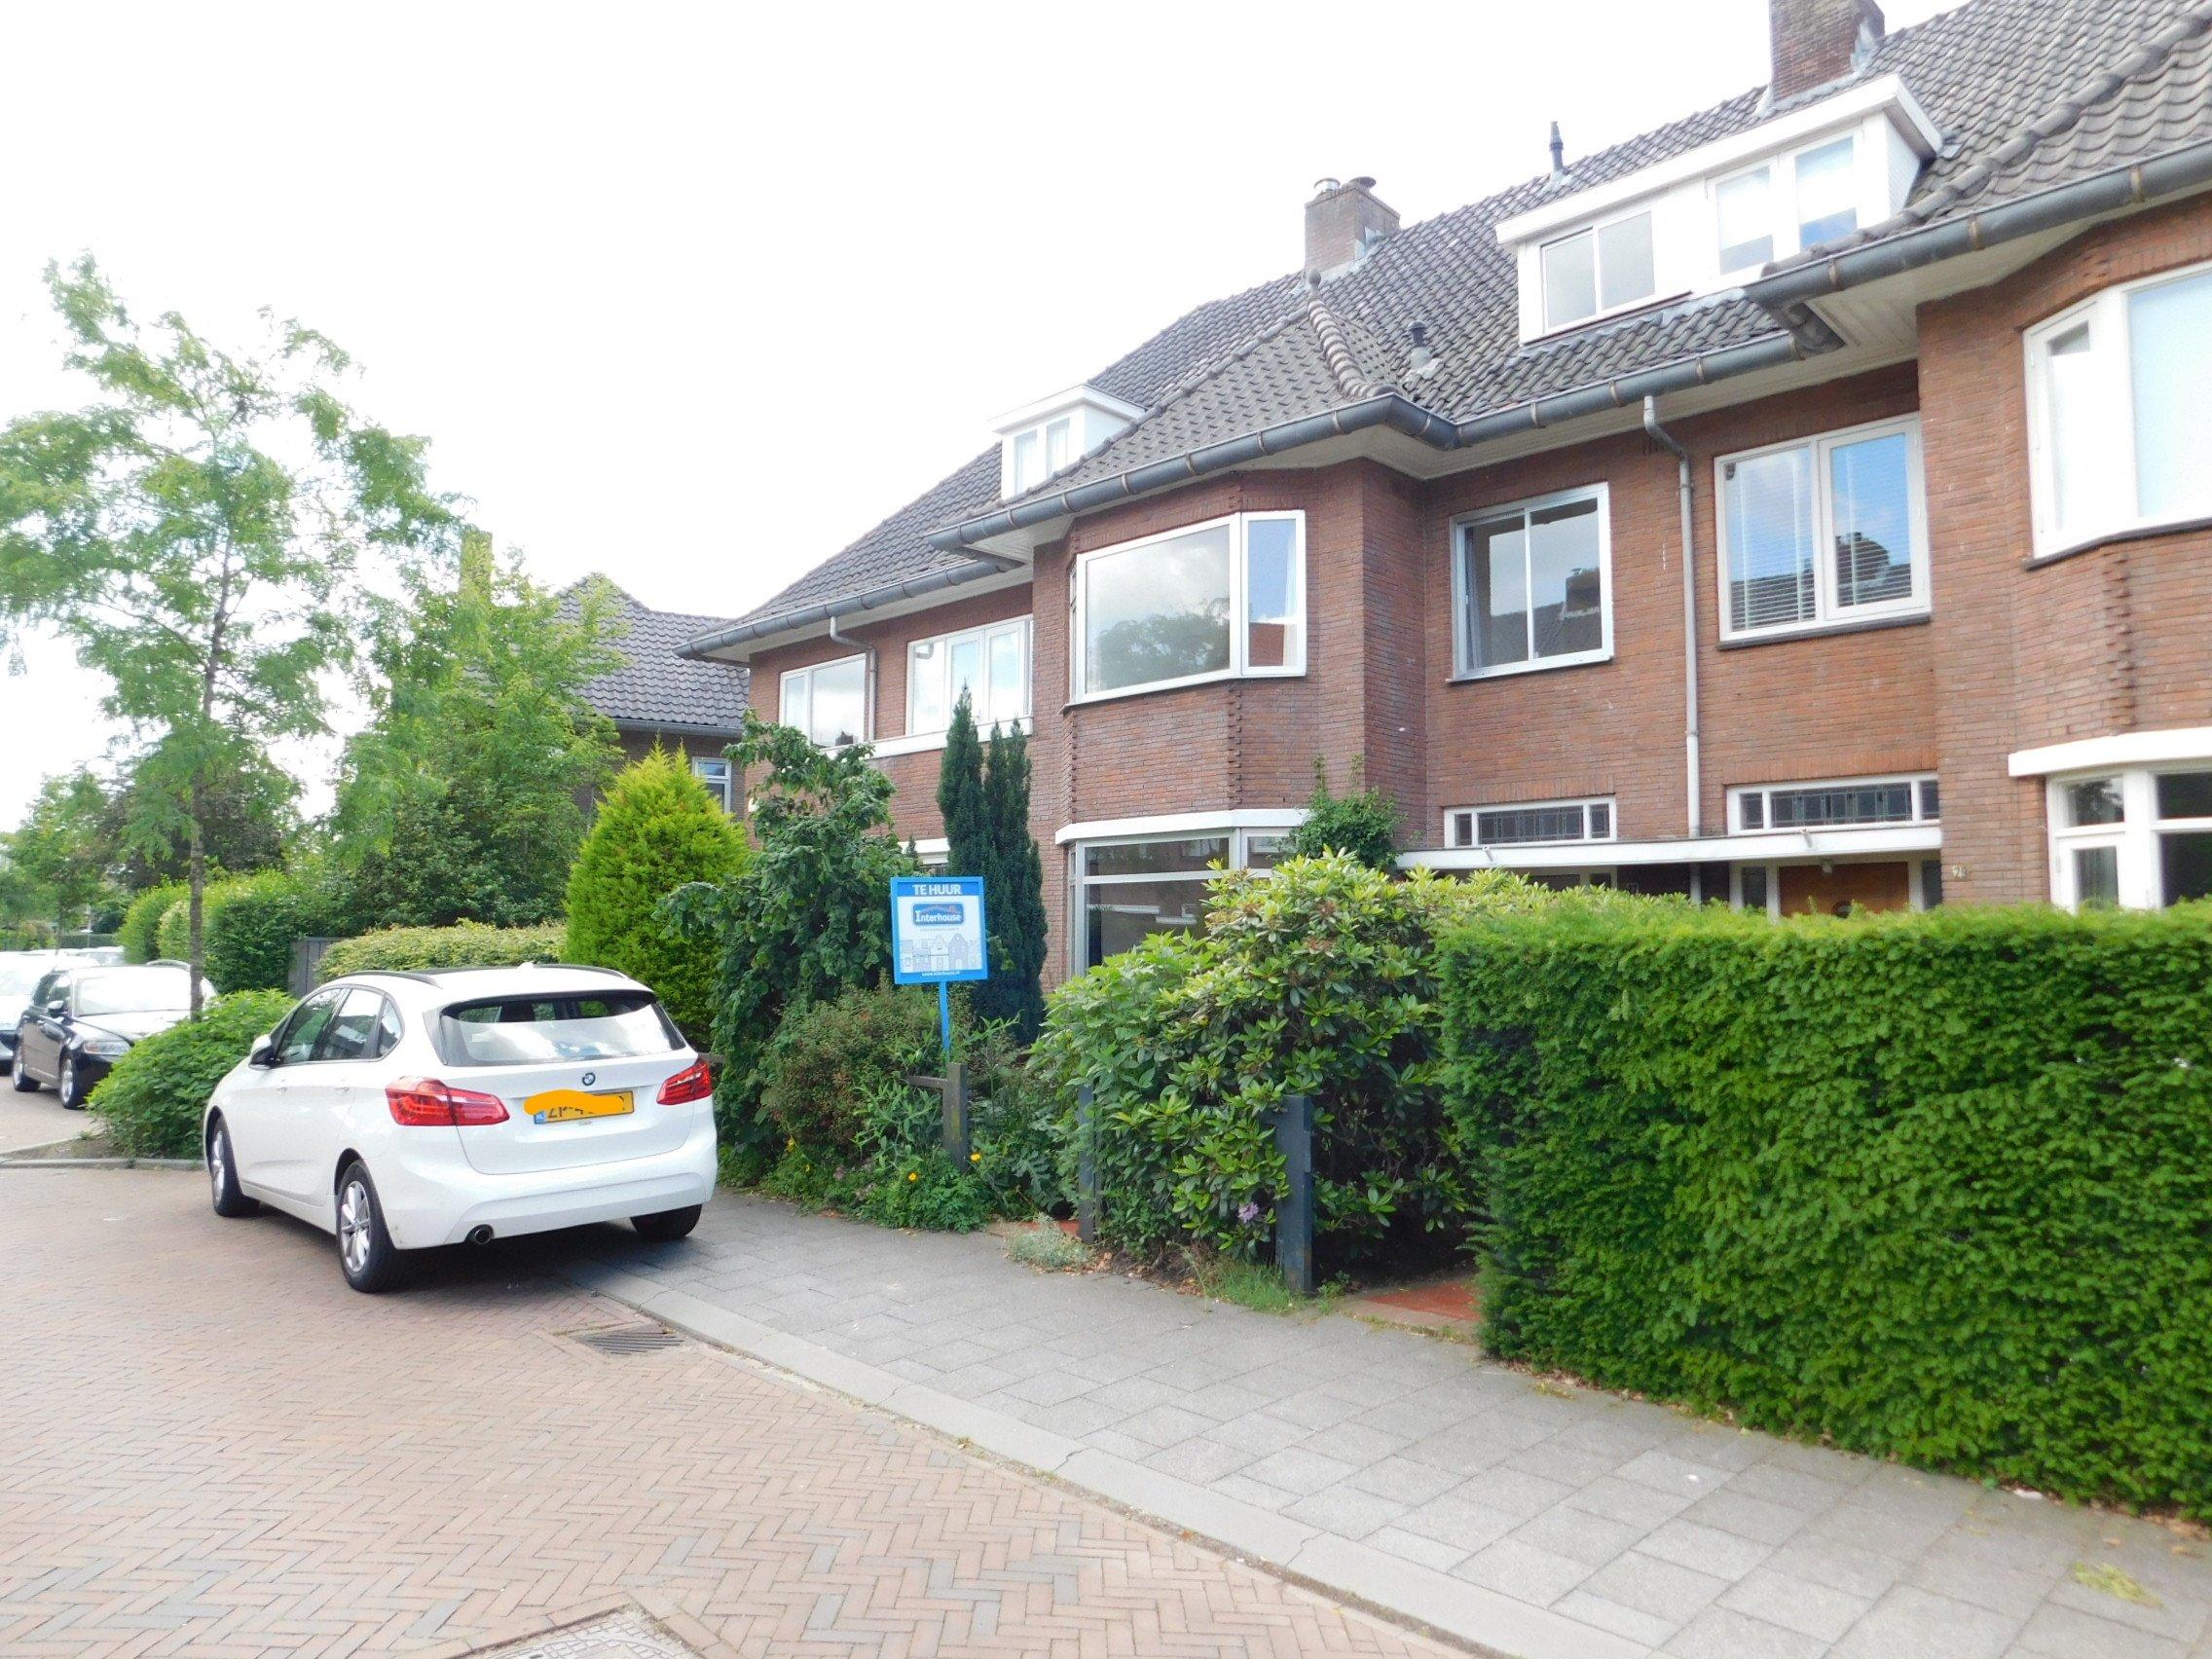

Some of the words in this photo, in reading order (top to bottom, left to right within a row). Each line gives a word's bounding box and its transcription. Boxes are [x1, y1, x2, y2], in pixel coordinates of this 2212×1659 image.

[912, 884, 927, 896] TE
[928, 883, 962, 895] HUUR
[915, 909, 962, 923] Interhouse
